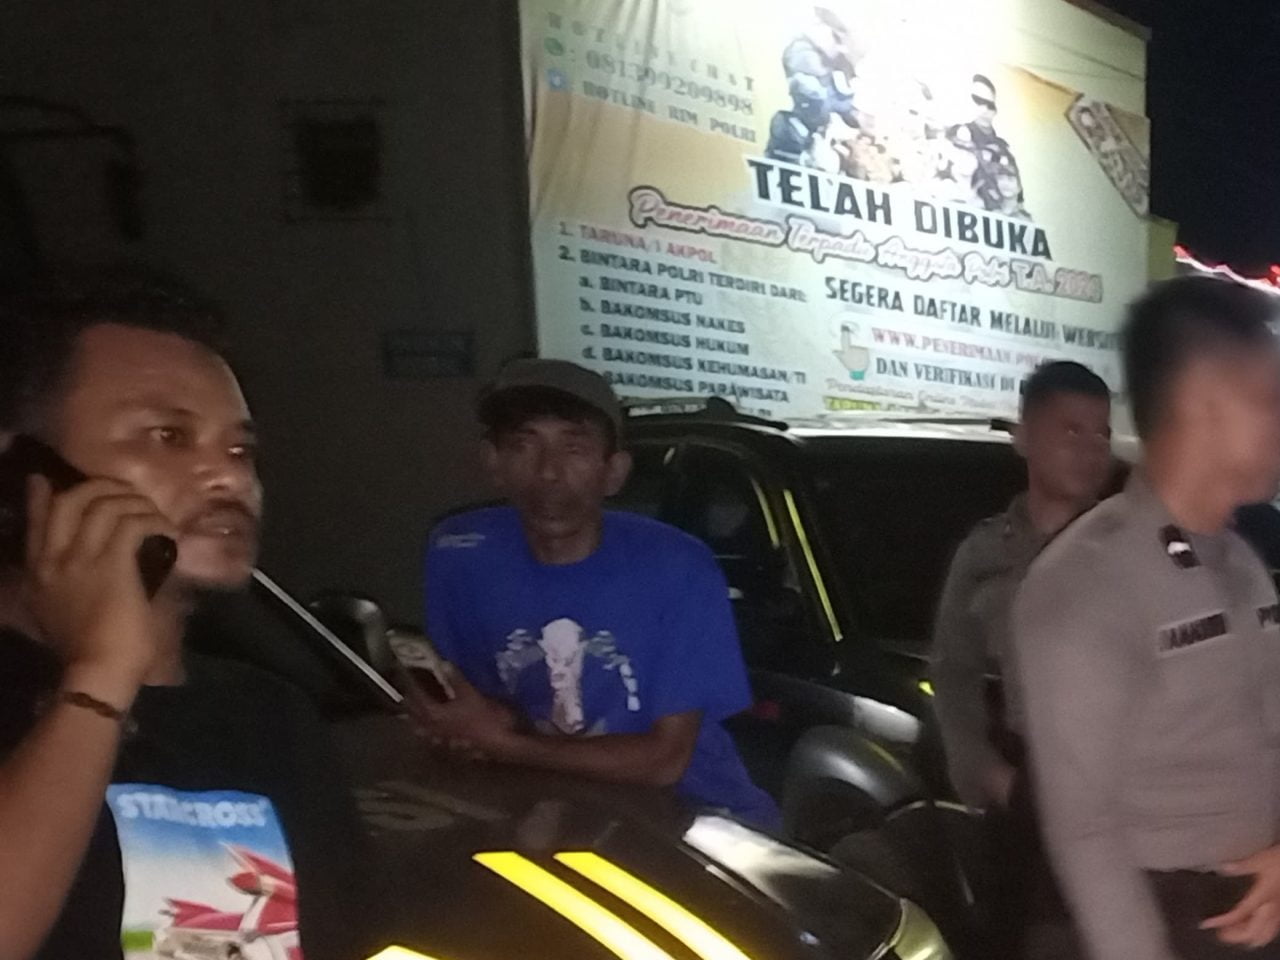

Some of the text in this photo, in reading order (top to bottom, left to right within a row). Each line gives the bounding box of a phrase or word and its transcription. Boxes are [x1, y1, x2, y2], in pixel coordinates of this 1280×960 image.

[709, 117, 756, 143] POLRI
[635, 190, 780, 241] Penerimaan
[747, 159, 1053, 262] TELAH DIBUKA
[666, 243, 718, 263] AKPOL
[558, 246, 576, 261] 2.
[580, 250, 653, 275] BINTARA
[657, 263, 704, 283] POLRI
[708, 272, 766, 295] TERDIRI
[579, 277, 703, 305] a. BINTARA PTU
[825, 277, 904, 312] SEGERA
[913, 294, 981, 328] DAFTAR
[990, 309, 1060, 338] MELALUI
[579, 298, 746, 334] b. BAKOMSUS NAKES
[601, 323, 691, 348] BAKOMSUS
[695, 336, 750, 356] HUKUM
[582, 346, 596, 359] d.
[602, 347, 693, 372] BAKOMSUS
[876, 357, 909, 377] DAN
[913, 362, 996, 391] VERIFIKASI
